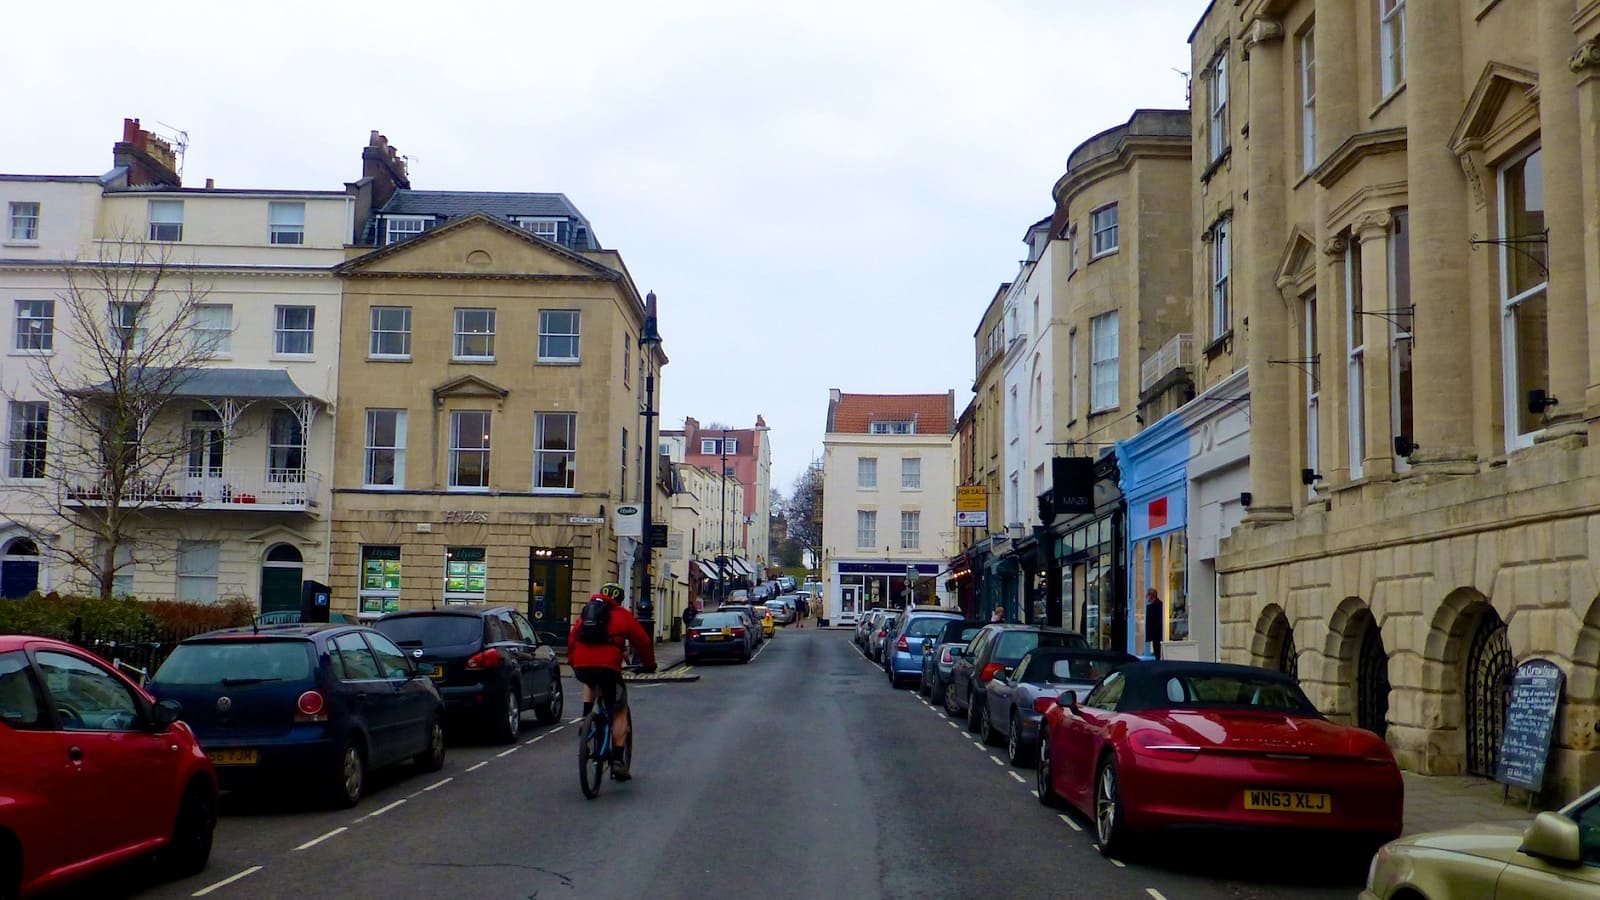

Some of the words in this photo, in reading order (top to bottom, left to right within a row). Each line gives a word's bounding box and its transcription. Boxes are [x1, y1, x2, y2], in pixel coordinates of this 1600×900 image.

[446, 510, 488, 526] Hydes
[317, 595, 326, 603] P
[1250, 791, 1291, 807] WN63
[1296, 793, 1325, 809] XLJ
